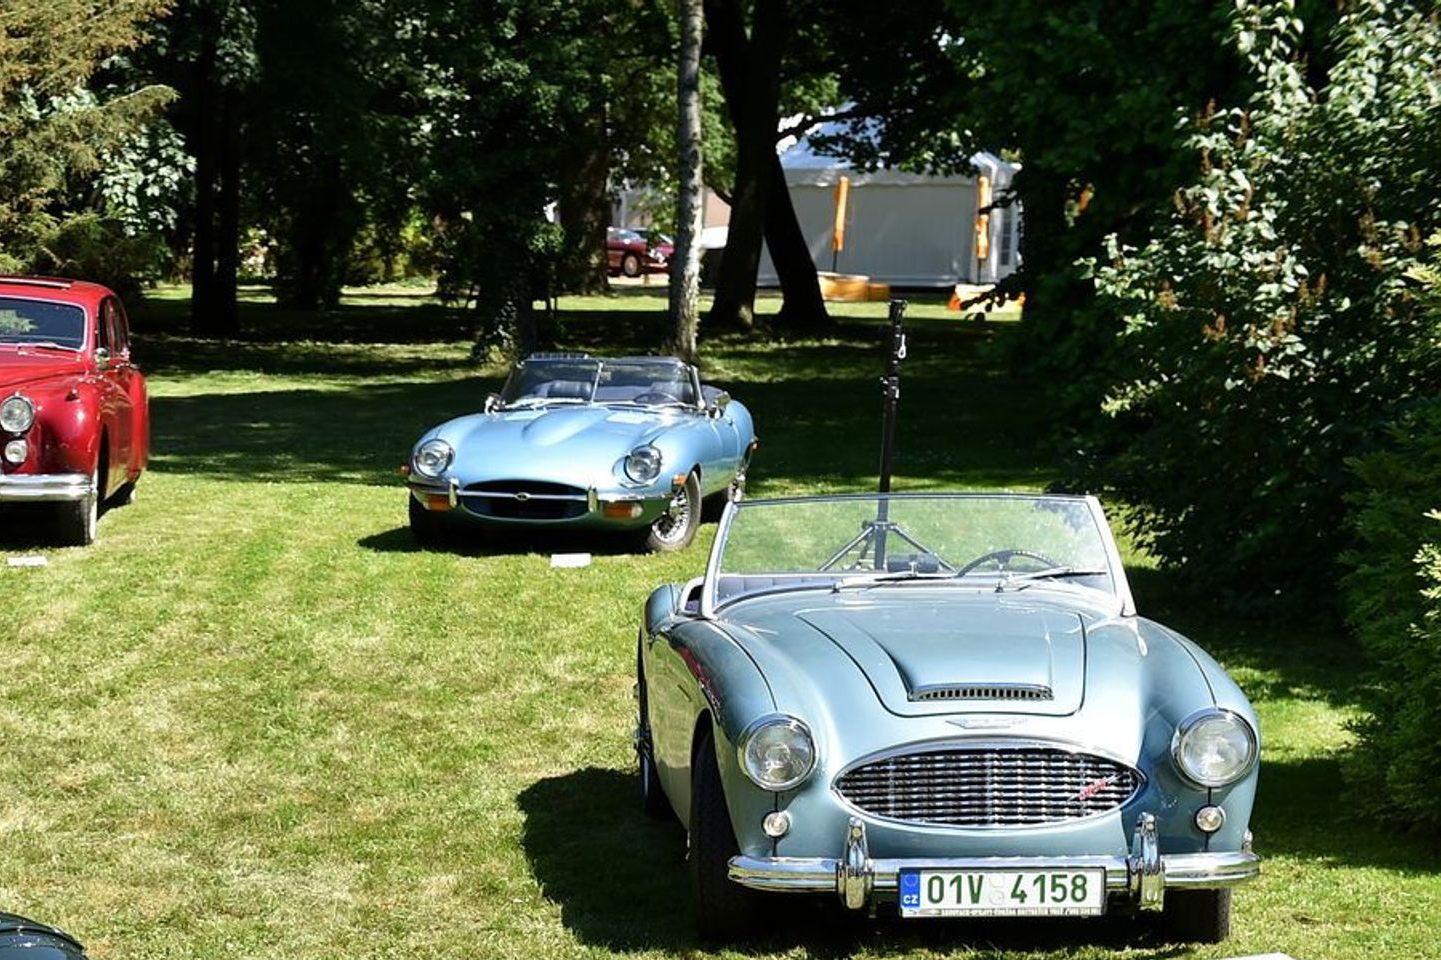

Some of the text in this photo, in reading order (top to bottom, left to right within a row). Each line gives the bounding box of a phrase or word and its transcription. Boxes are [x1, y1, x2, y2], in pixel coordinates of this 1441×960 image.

[927, 874, 1088, 904] 01V 4158
[903, 895, 918, 905] CZ
